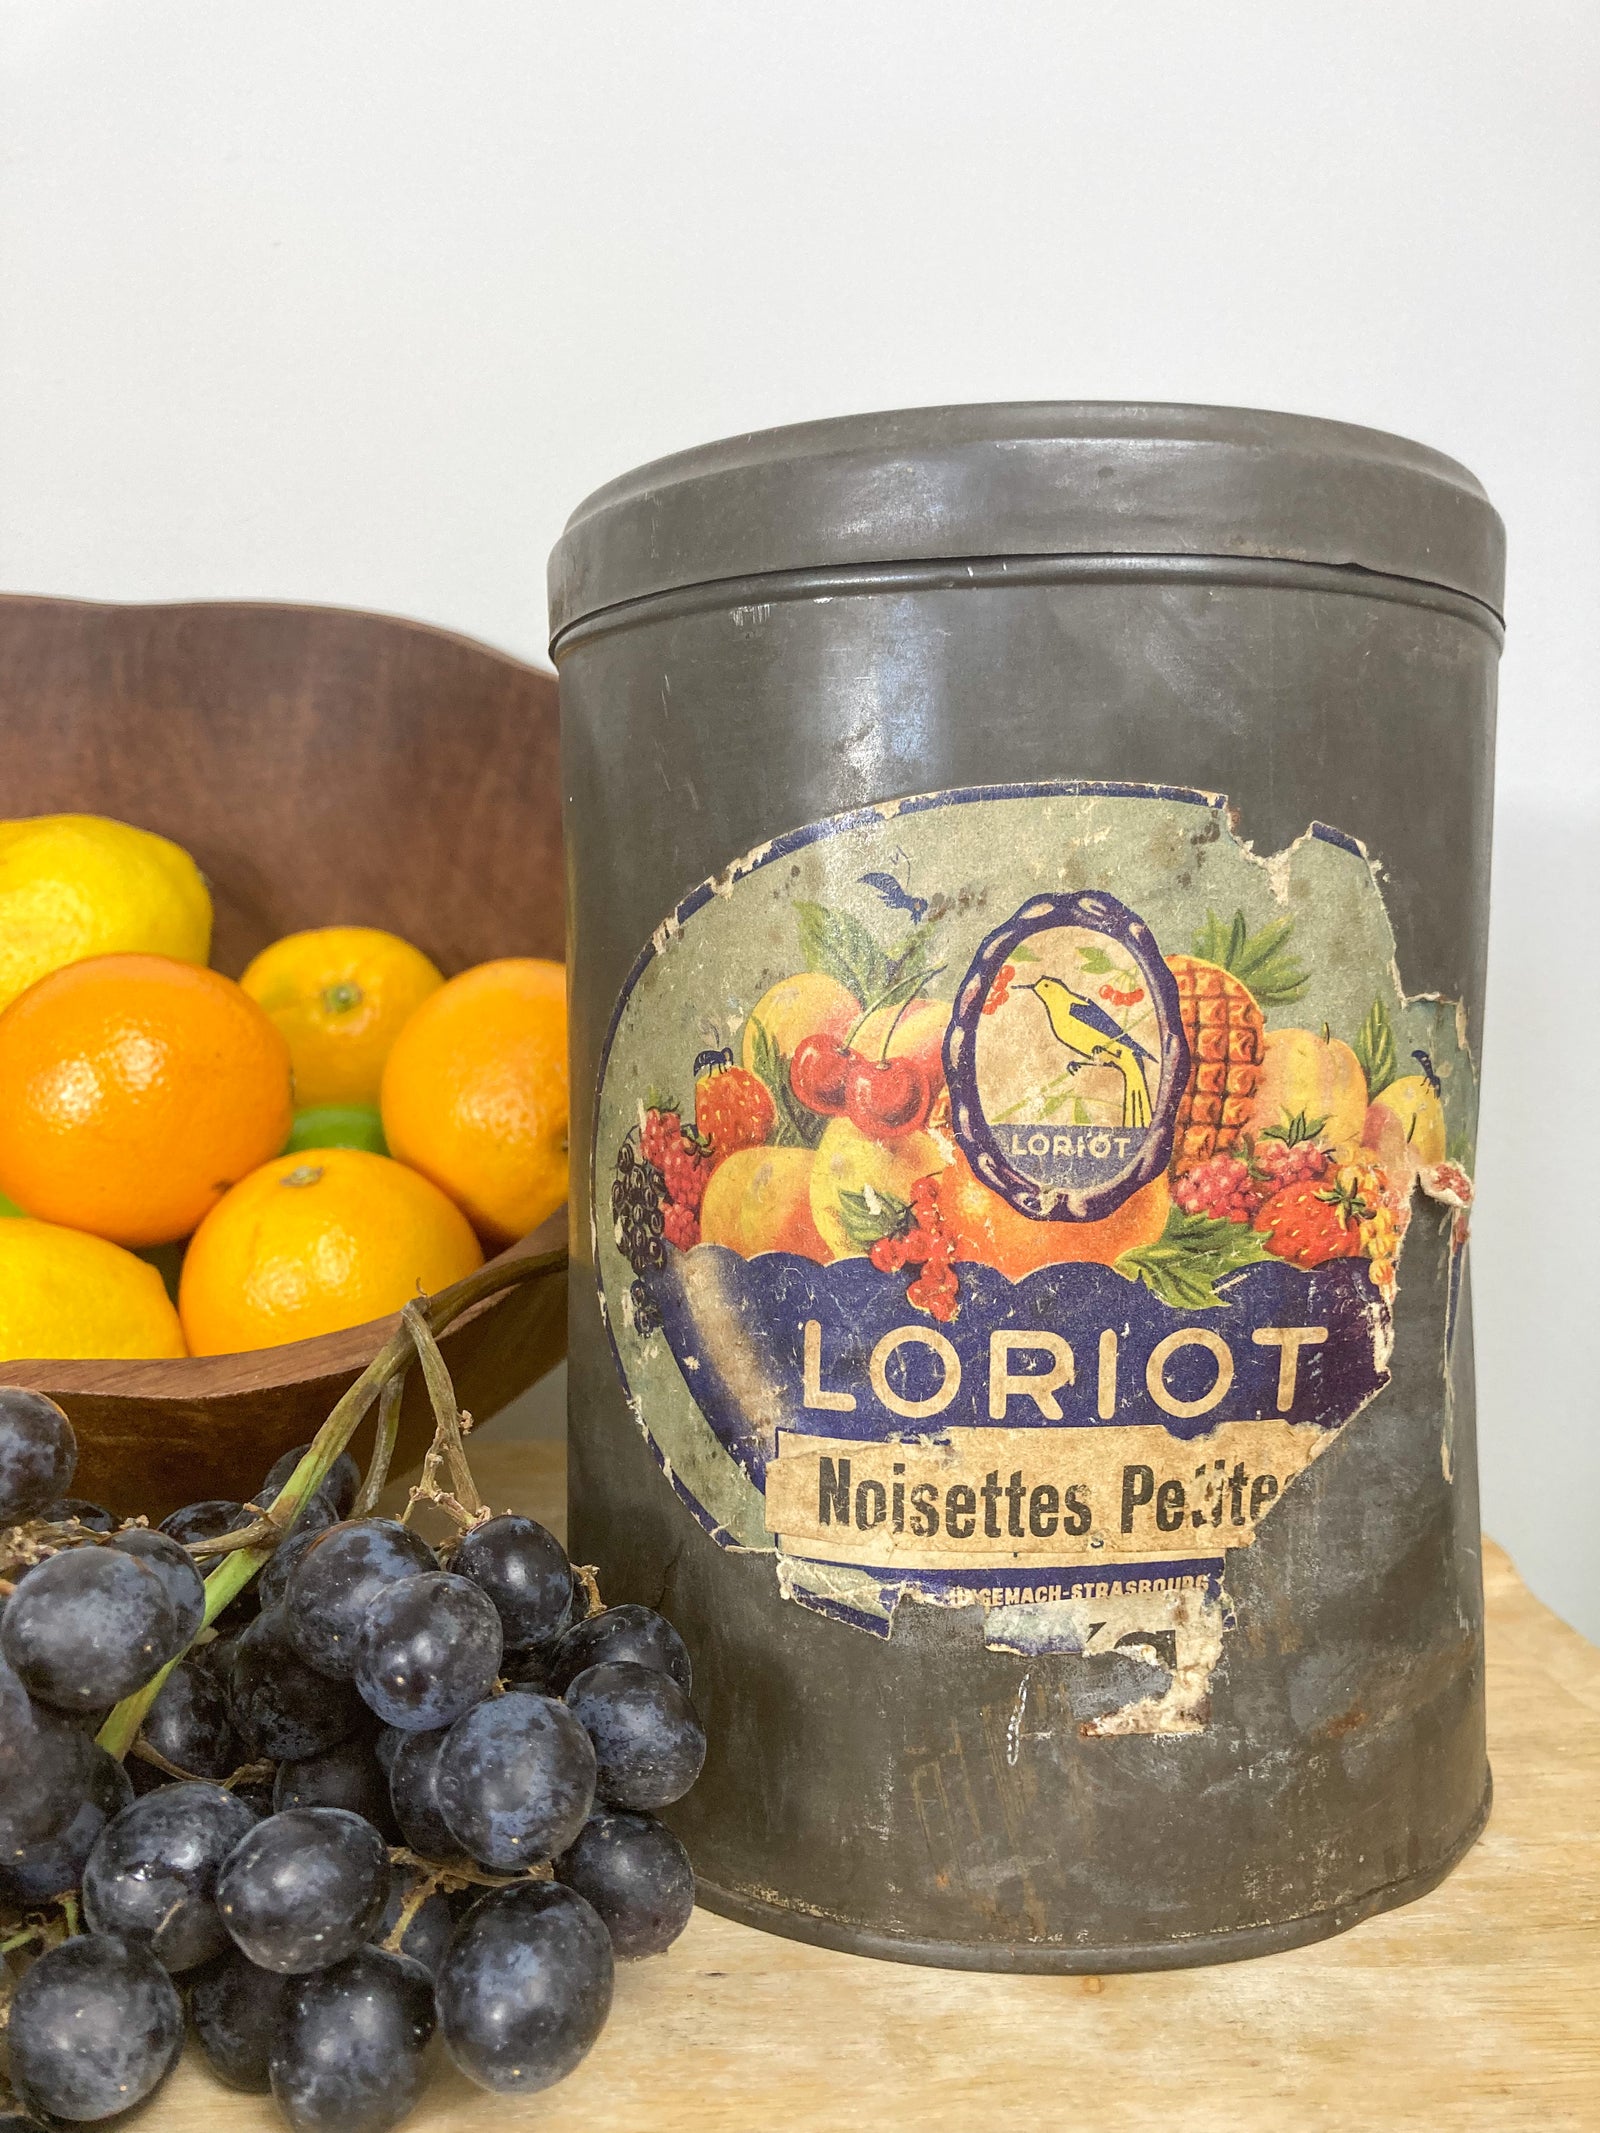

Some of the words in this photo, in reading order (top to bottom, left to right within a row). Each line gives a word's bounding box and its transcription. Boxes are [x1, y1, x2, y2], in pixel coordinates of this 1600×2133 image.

[1011, 1132, 1131, 1158] LORIOT
[803, 1320, 1329, 1420] LORIOT
[818, 1456, 1093, 1539] Noisettes
